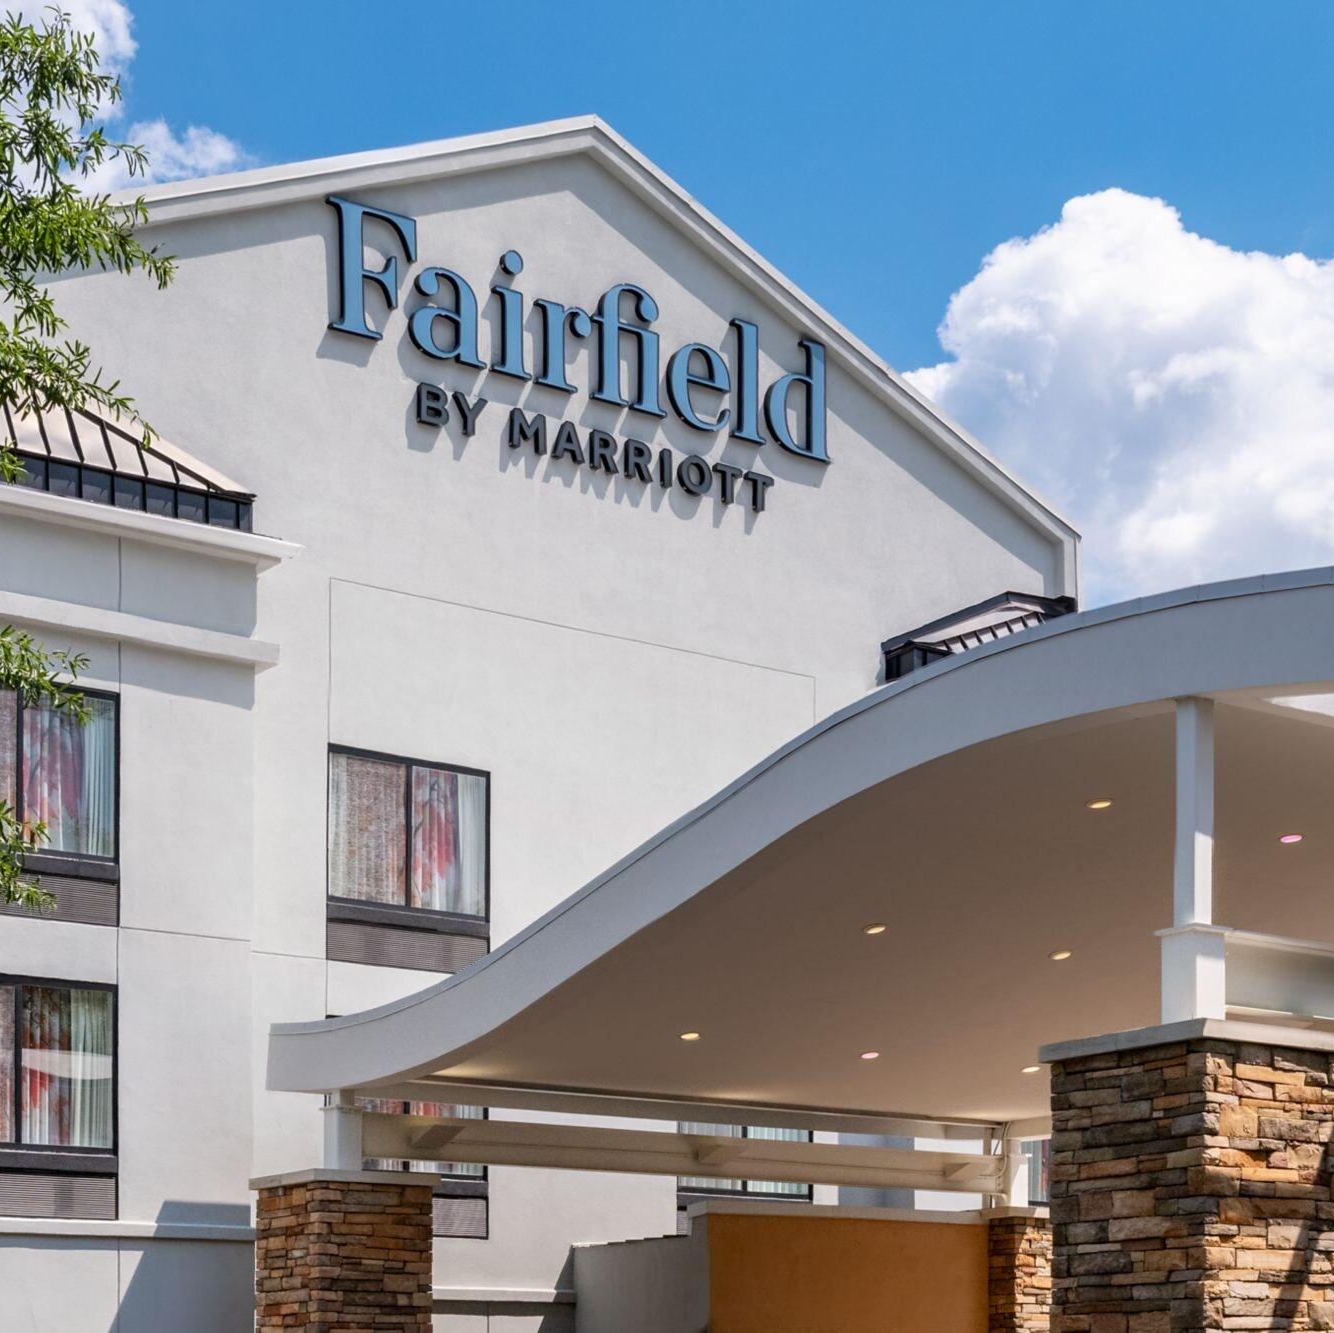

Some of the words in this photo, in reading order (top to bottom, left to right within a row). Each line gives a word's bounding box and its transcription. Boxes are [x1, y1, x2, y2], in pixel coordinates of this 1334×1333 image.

[326, 196, 830, 464] Fairfield
[416, 382, 487, 437] BY
[508, 407, 774, 513] MARRIOTT
